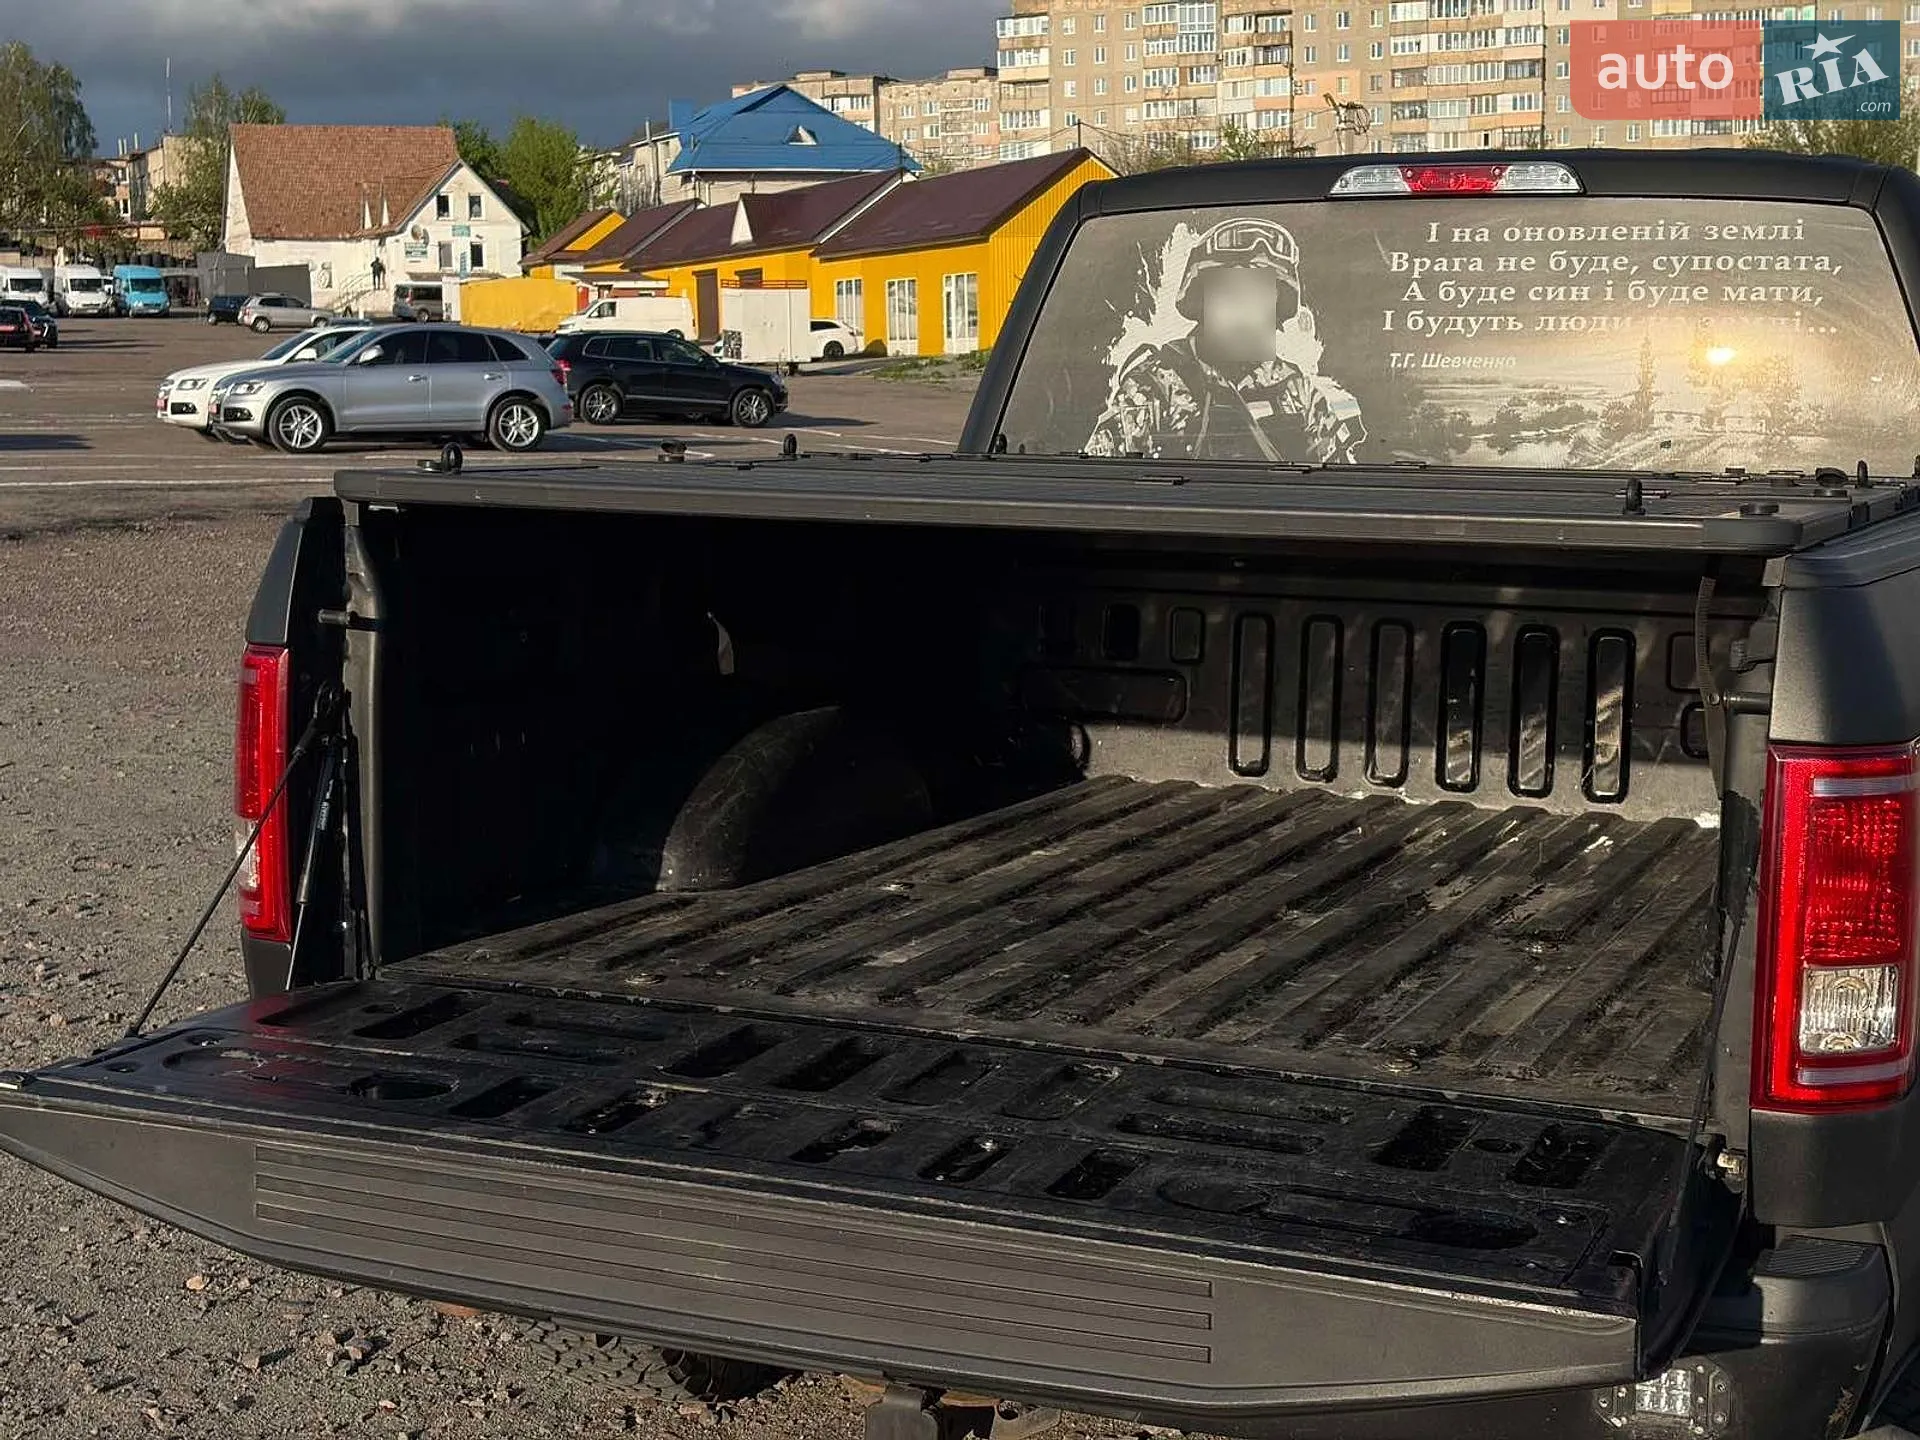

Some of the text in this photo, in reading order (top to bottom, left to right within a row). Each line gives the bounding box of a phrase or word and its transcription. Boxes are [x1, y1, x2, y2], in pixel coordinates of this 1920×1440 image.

[1426, 219, 1805, 242] І на оновленій землі
[1390, 250, 1843, 279] Врага не буде, супостата,
[1401, 279, 1824, 308] А буде син і буде мати,
[1382, 310, 1395, 331] І
[1406, 310, 1524, 338] будуть
[1535, 315, 1633, 335] люди
[1389, 352, 1517, 369] Т.Г. Шевченко
